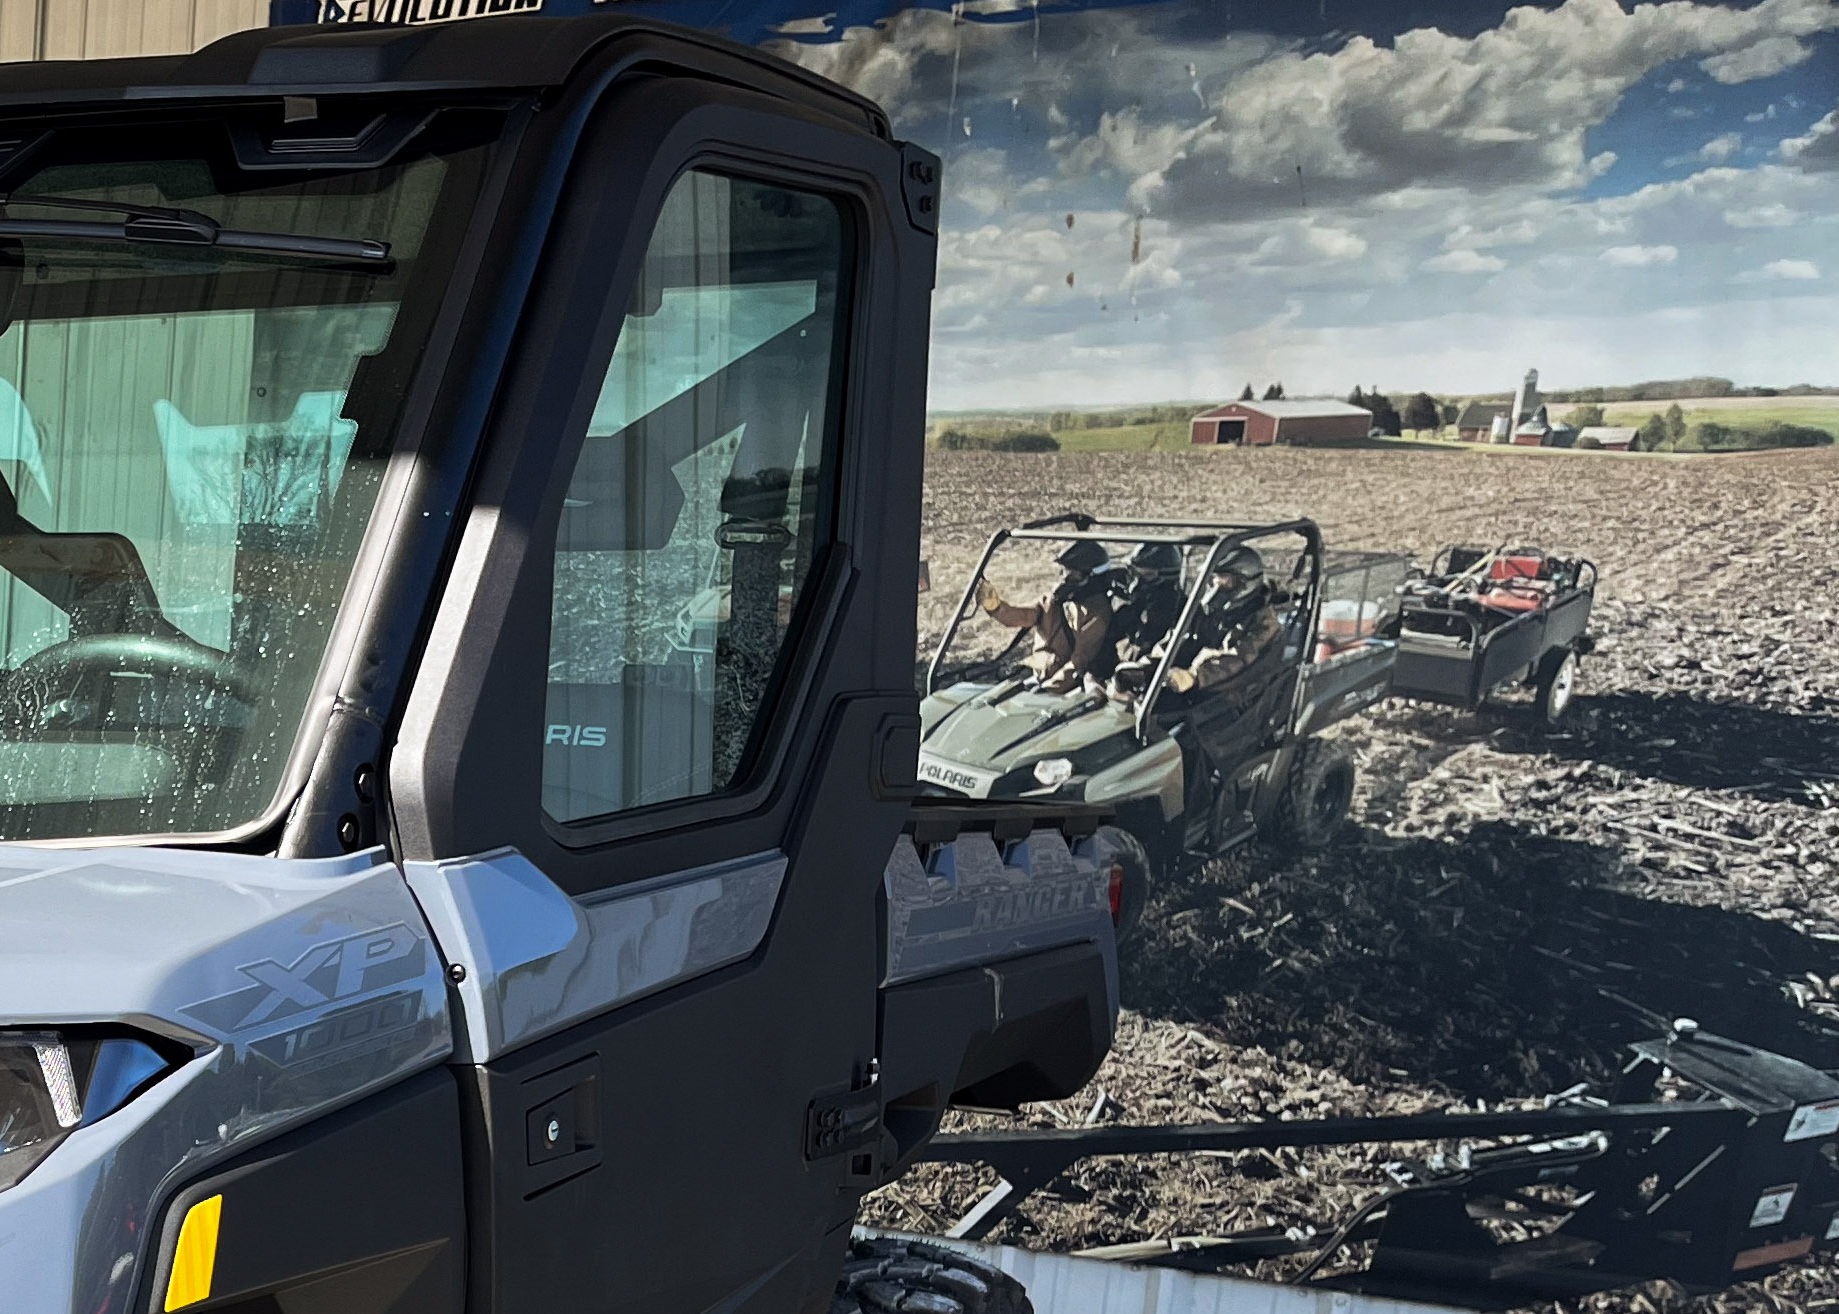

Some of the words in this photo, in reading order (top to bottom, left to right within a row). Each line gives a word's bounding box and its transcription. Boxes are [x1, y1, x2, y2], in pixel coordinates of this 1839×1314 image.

[919, 761, 977, 789] POLARIS
[972, 878, 1090, 932] RANGER
[233, 920, 419, 1030] XP
